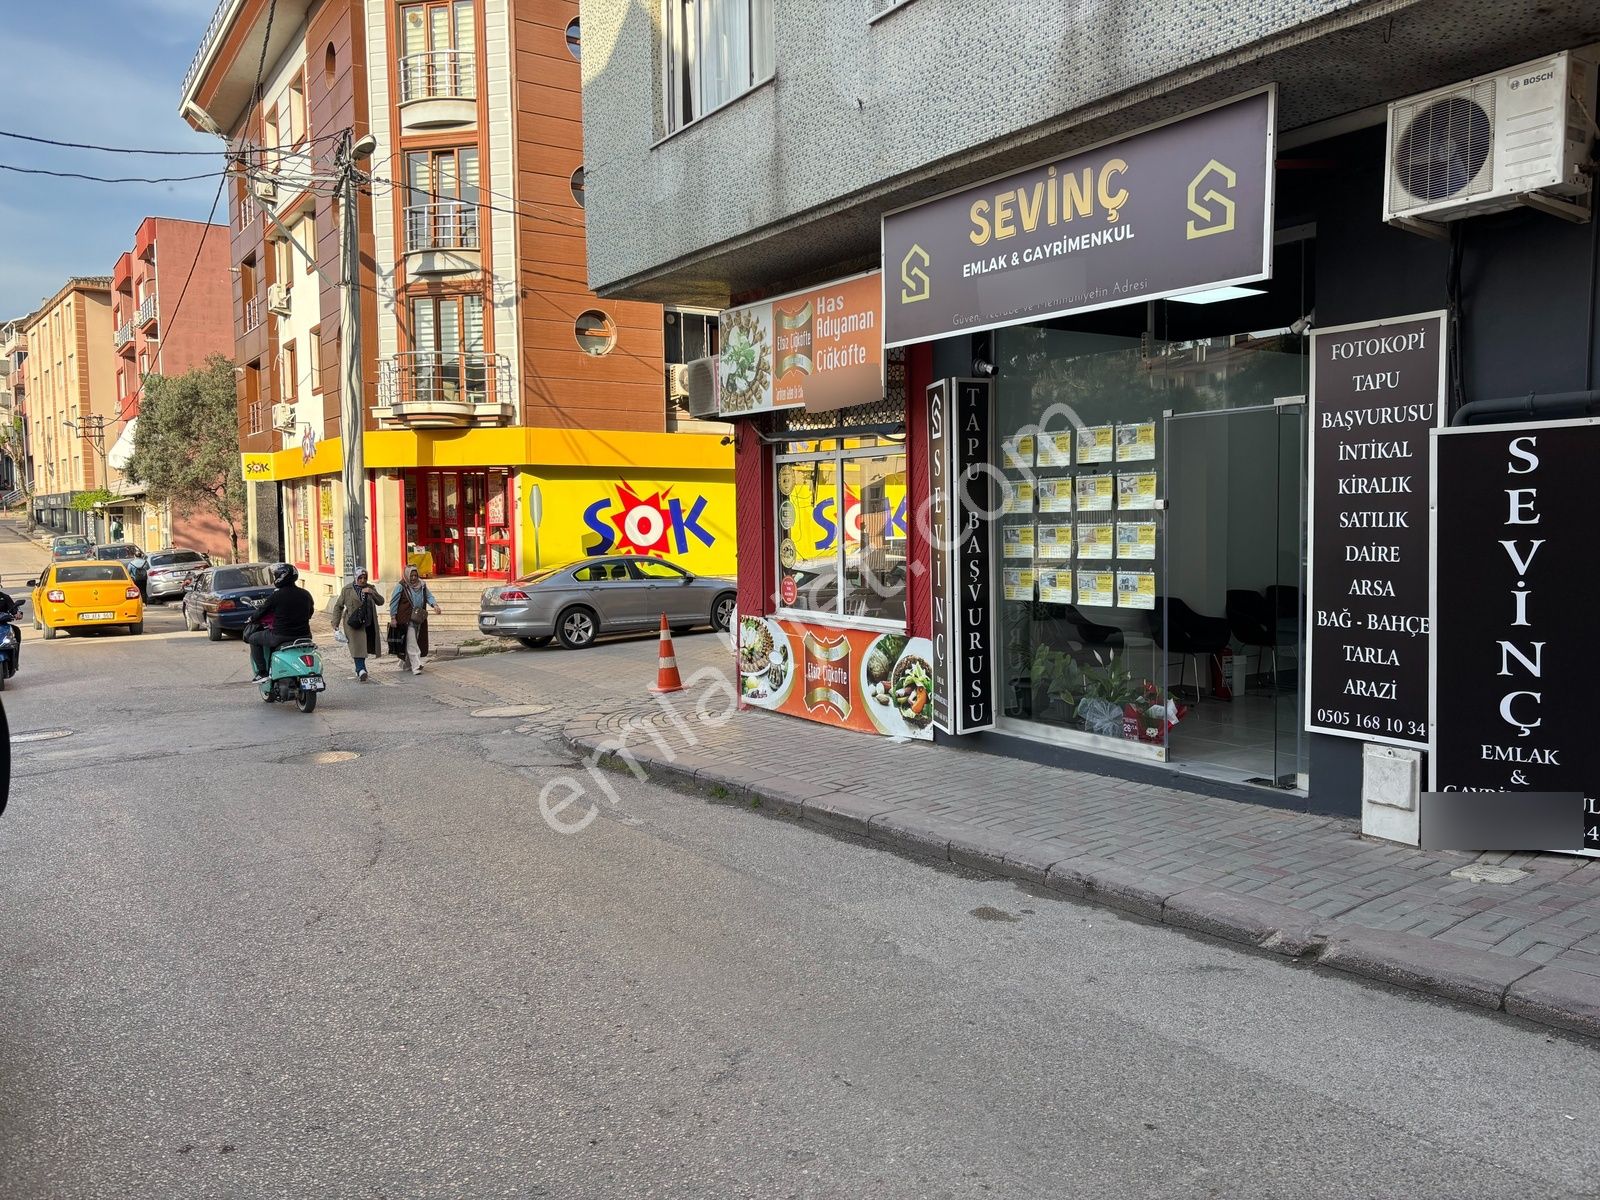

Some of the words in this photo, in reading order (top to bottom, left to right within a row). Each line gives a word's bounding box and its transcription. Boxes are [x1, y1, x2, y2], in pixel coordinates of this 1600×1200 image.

[1523, 71, 1553, 86] BOSCH
[969, 158, 1130, 247] SEVİNÇ
[963, 254, 1007, 278] EMLAK
[1011, 251, 1020, 266] &
[1023, 223, 1135, 263] GAYRİMENKUL
[1113, 278, 1148, 295] Adresi
[817, 295, 844, 315] Has
[817, 310, 874, 342] Adıyaman
[1331, 328, 1426, 361] FOTOKOPİ
[817, 343, 866, 373] Çiğköfte
[1352, 371, 1400, 392] TAPU
[1321, 403, 1434, 431] BAŞVURUSU
[965, 387, 981, 481] TAPU
[1338, 439, 1413, 461] İNTİKAL
[1338, 474, 1412, 495] KİRALIK
[1339, 511, 1409, 528] SATILIK
[934, 449, 944, 667] SEVİNÇ
[1345, 542, 1401, 563] DAİRE
[1348, 579, 1396, 597] ARSA
[1496, 436, 1547, 737] SEVİNÇ
[967, 511, 985, 722] BAŞVURUSU
[1317, 608, 1352, 628] BAĞ
[1367, 613, 1430, 637] BAHÇE
[1343, 645, 1400, 666] TARLA
[1343, 679, 1398, 700] ARAZİ
[1317, 708, 1350, 725] 0505
[1356, 714, 1380, 730] 168
[1386, 718, 1403, 733] 10
[1407, 721, 1426, 737] 34
[1481, 744, 1560, 766] EMLAK
[1510, 769, 1530, 786] &
